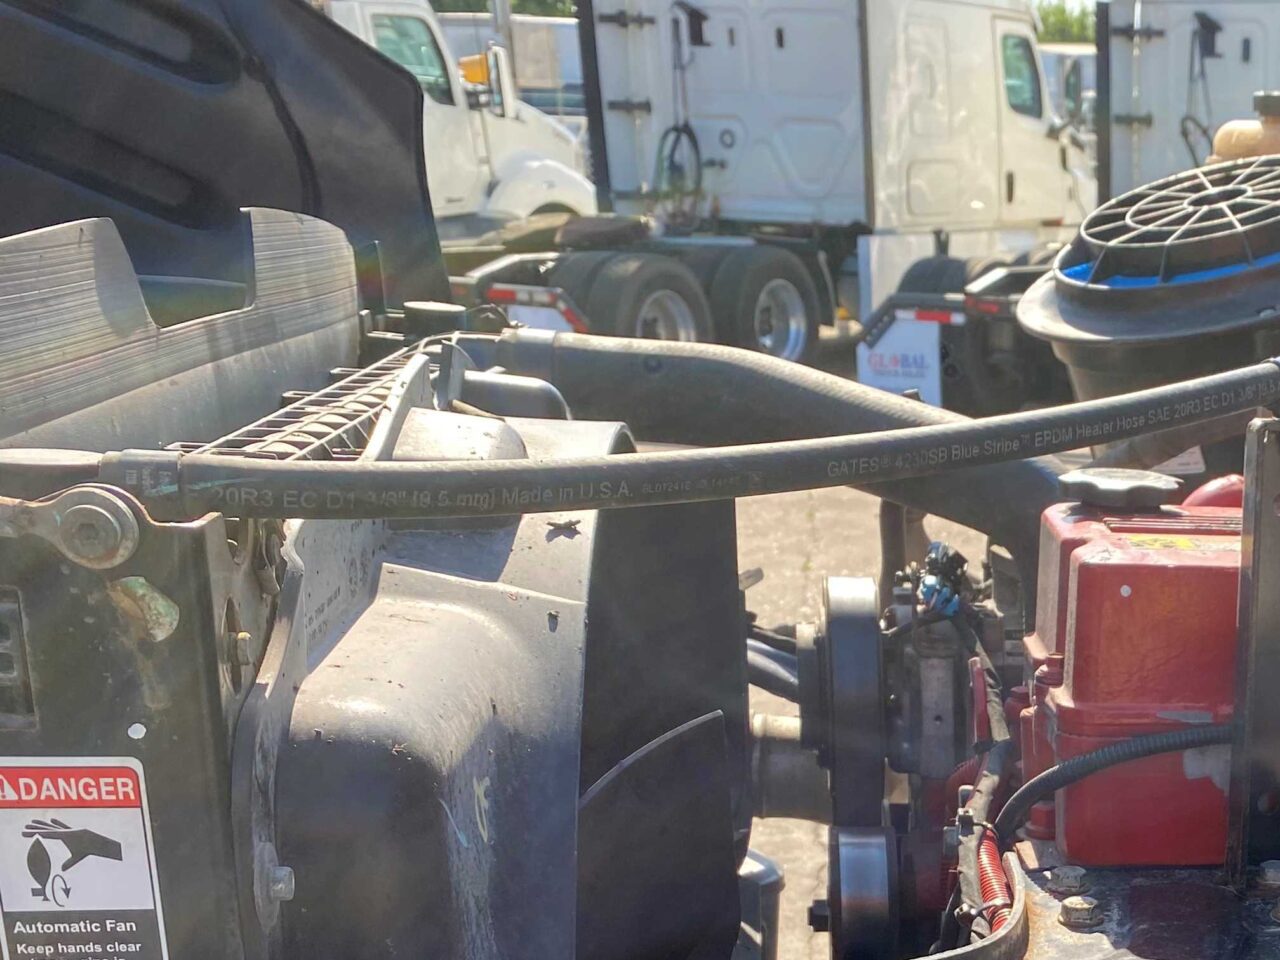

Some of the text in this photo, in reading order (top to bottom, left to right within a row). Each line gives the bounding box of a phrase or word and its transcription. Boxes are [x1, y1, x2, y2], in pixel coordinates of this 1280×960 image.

[951, 442, 980, 461] Blue
[1035, 426, 1073, 449] EPDM
[1075, 418, 1115, 441] Heater
[1116, 413, 1146, 433] Hose
[1147, 405, 1171, 426] SAE
[1173, 400, 1202, 420] 20R3
[1203, 395, 1220, 412] EC
[211, 487, 273, 507] 20R3
[283, 491, 317, 509] EC
[327, 491, 355, 509] D1
[502, 485, 554, 506] Made
[559, 485, 574, 502] in
[19, 777, 136, 801] DANGER
[14, 919, 137, 934] Automatic Fan
[16, 941, 142, 956] Keep hands clear
